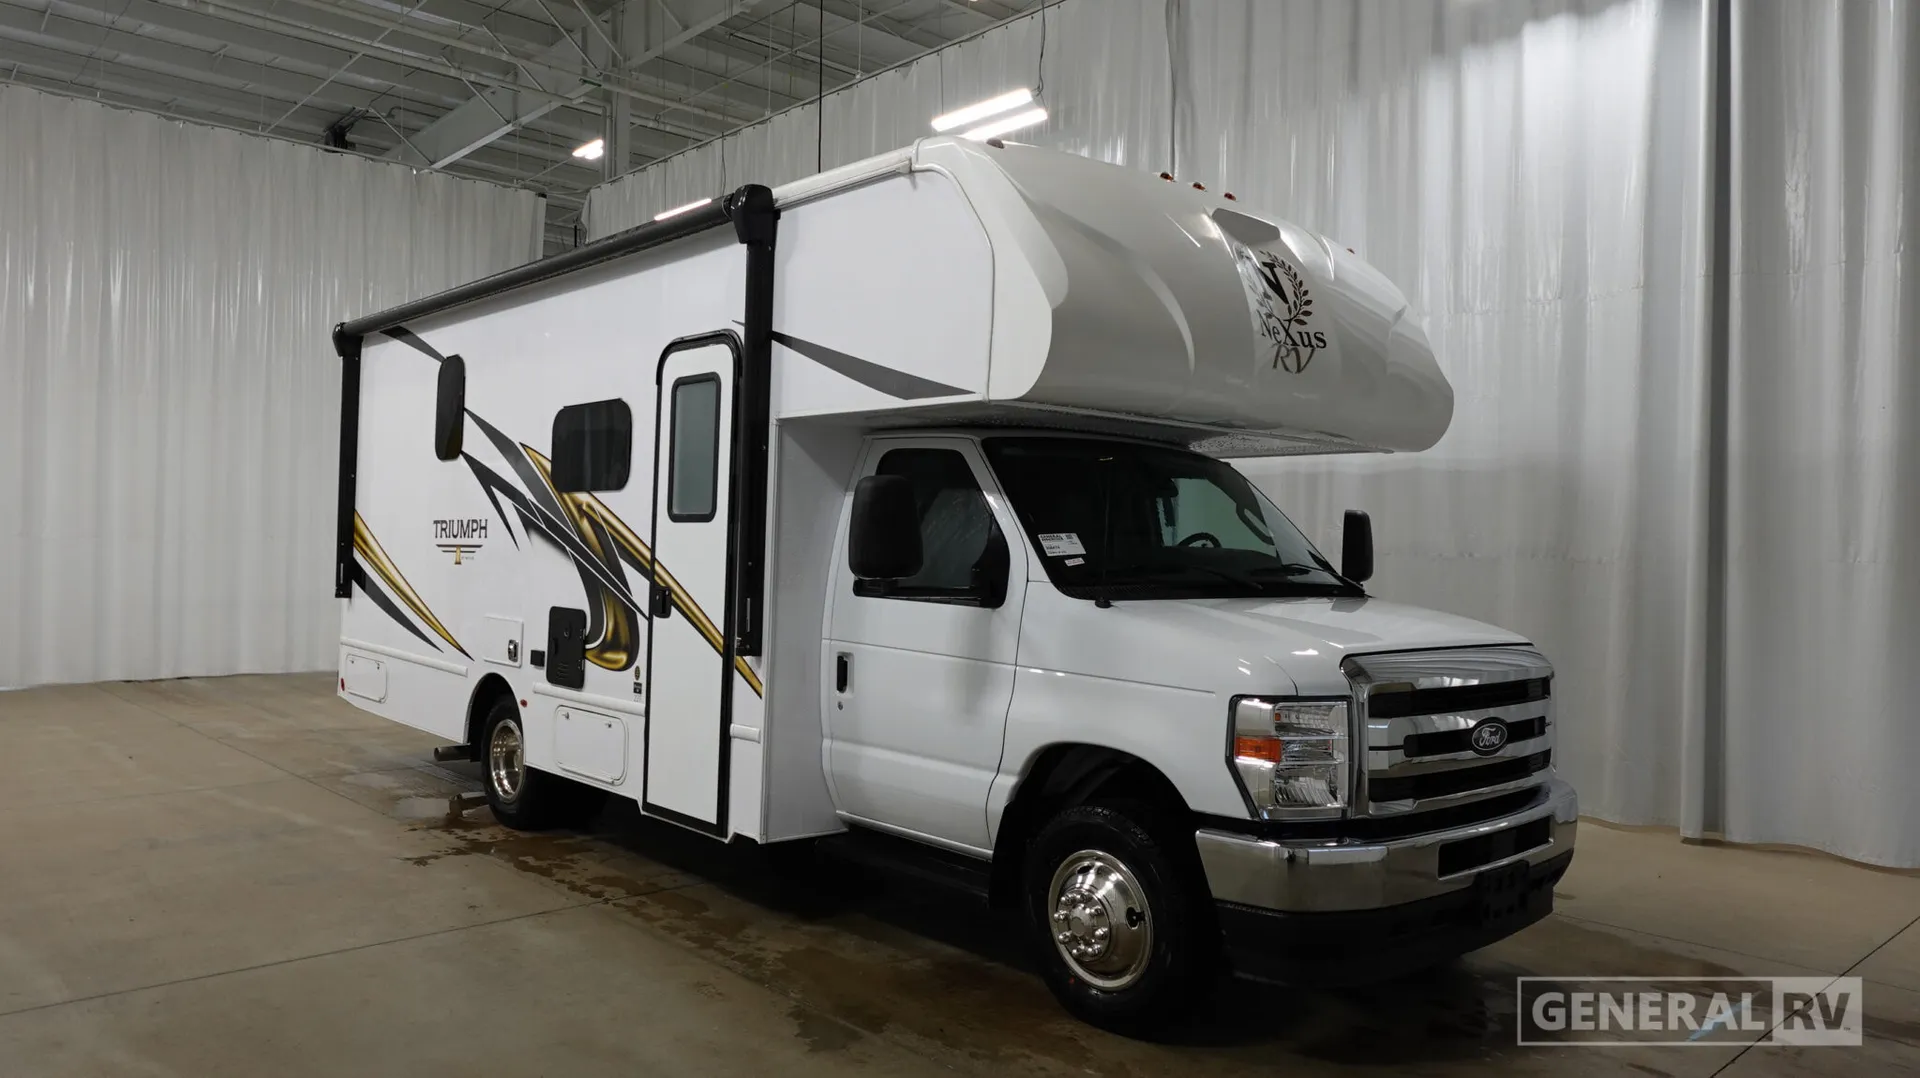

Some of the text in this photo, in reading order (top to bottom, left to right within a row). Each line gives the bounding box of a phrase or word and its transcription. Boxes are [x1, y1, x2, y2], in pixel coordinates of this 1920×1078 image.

[1271, 343, 1317, 374] RV
[433, 518, 488, 539] TRIUMPH
[1479, 727, 1501, 747] Ford
